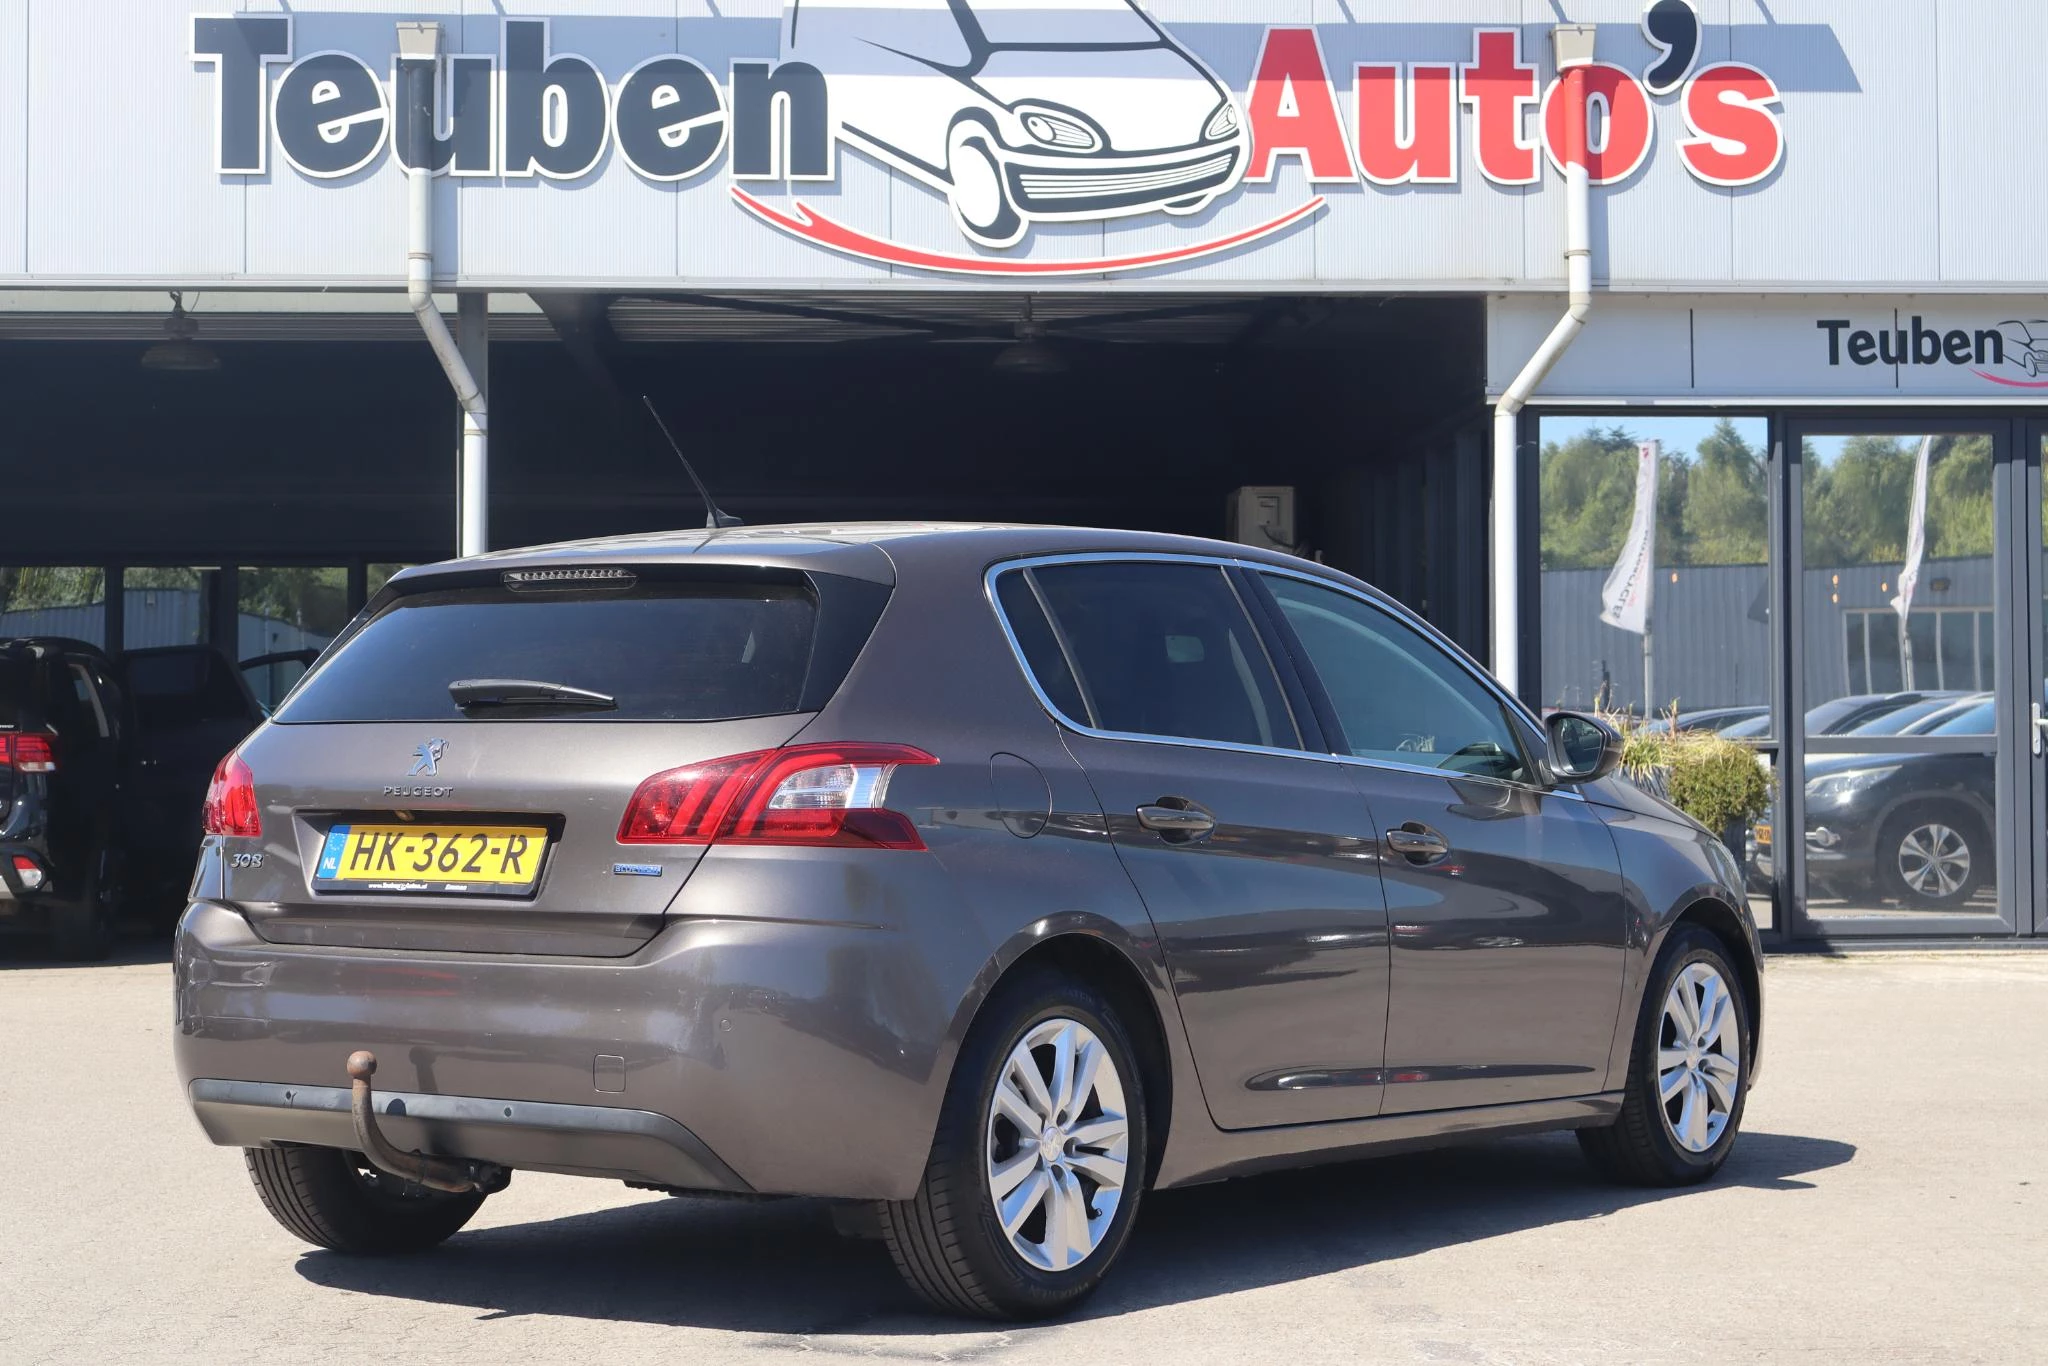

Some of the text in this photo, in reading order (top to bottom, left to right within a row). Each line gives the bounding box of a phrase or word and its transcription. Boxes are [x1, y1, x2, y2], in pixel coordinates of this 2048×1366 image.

[192, 0, 1784, 184] Teuben Auto's
[1816, 316, 2004, 365] Teuben
[383, 785, 454, 798] PEUGEOT
[231, 853, 264, 869] 308
[322, 857, 337, 870] NL
[349, 831, 528, 875] HK-362-R
